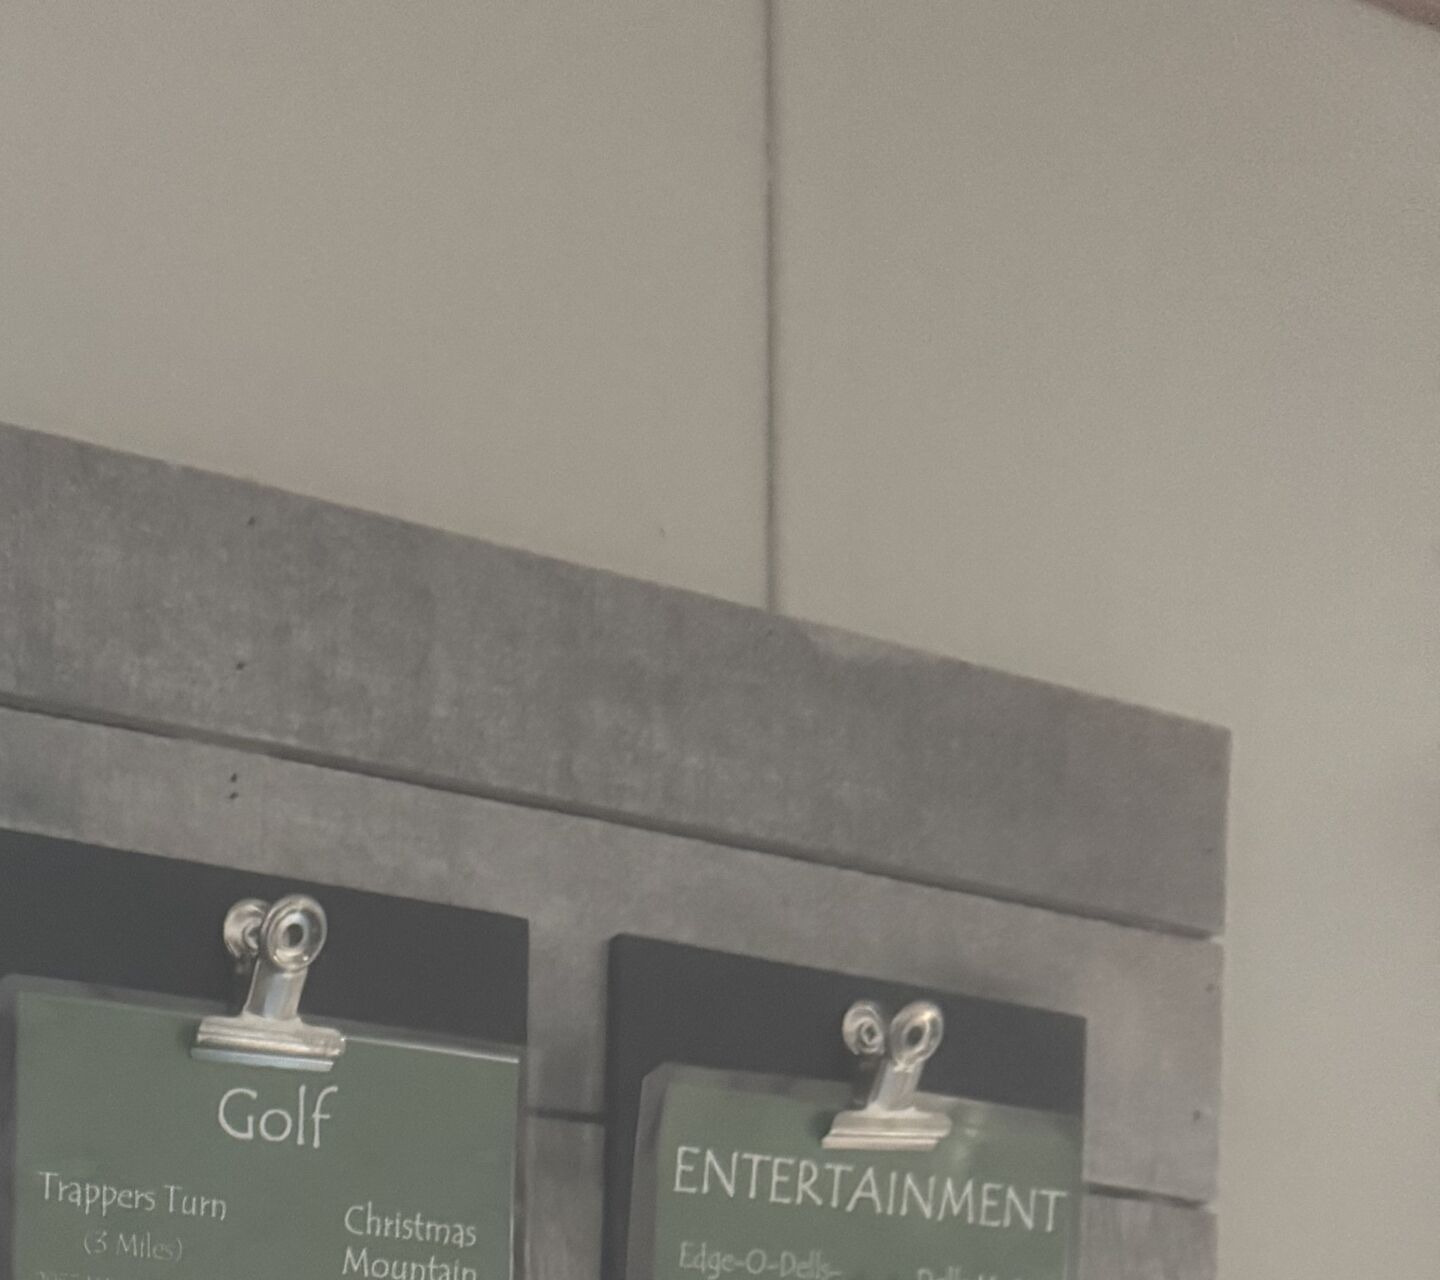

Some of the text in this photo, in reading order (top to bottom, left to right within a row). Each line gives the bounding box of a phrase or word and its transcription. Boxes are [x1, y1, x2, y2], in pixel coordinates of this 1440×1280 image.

[217, 1085, 339, 1150] Golf
[36, 1171, 227, 1221] Trappers Turn
[672, 1144, 1069, 1233] ENTERTAINMENT
[116, 1232, 184, 1263] Miles)
[343, 1200, 477, 1249] Christmas
